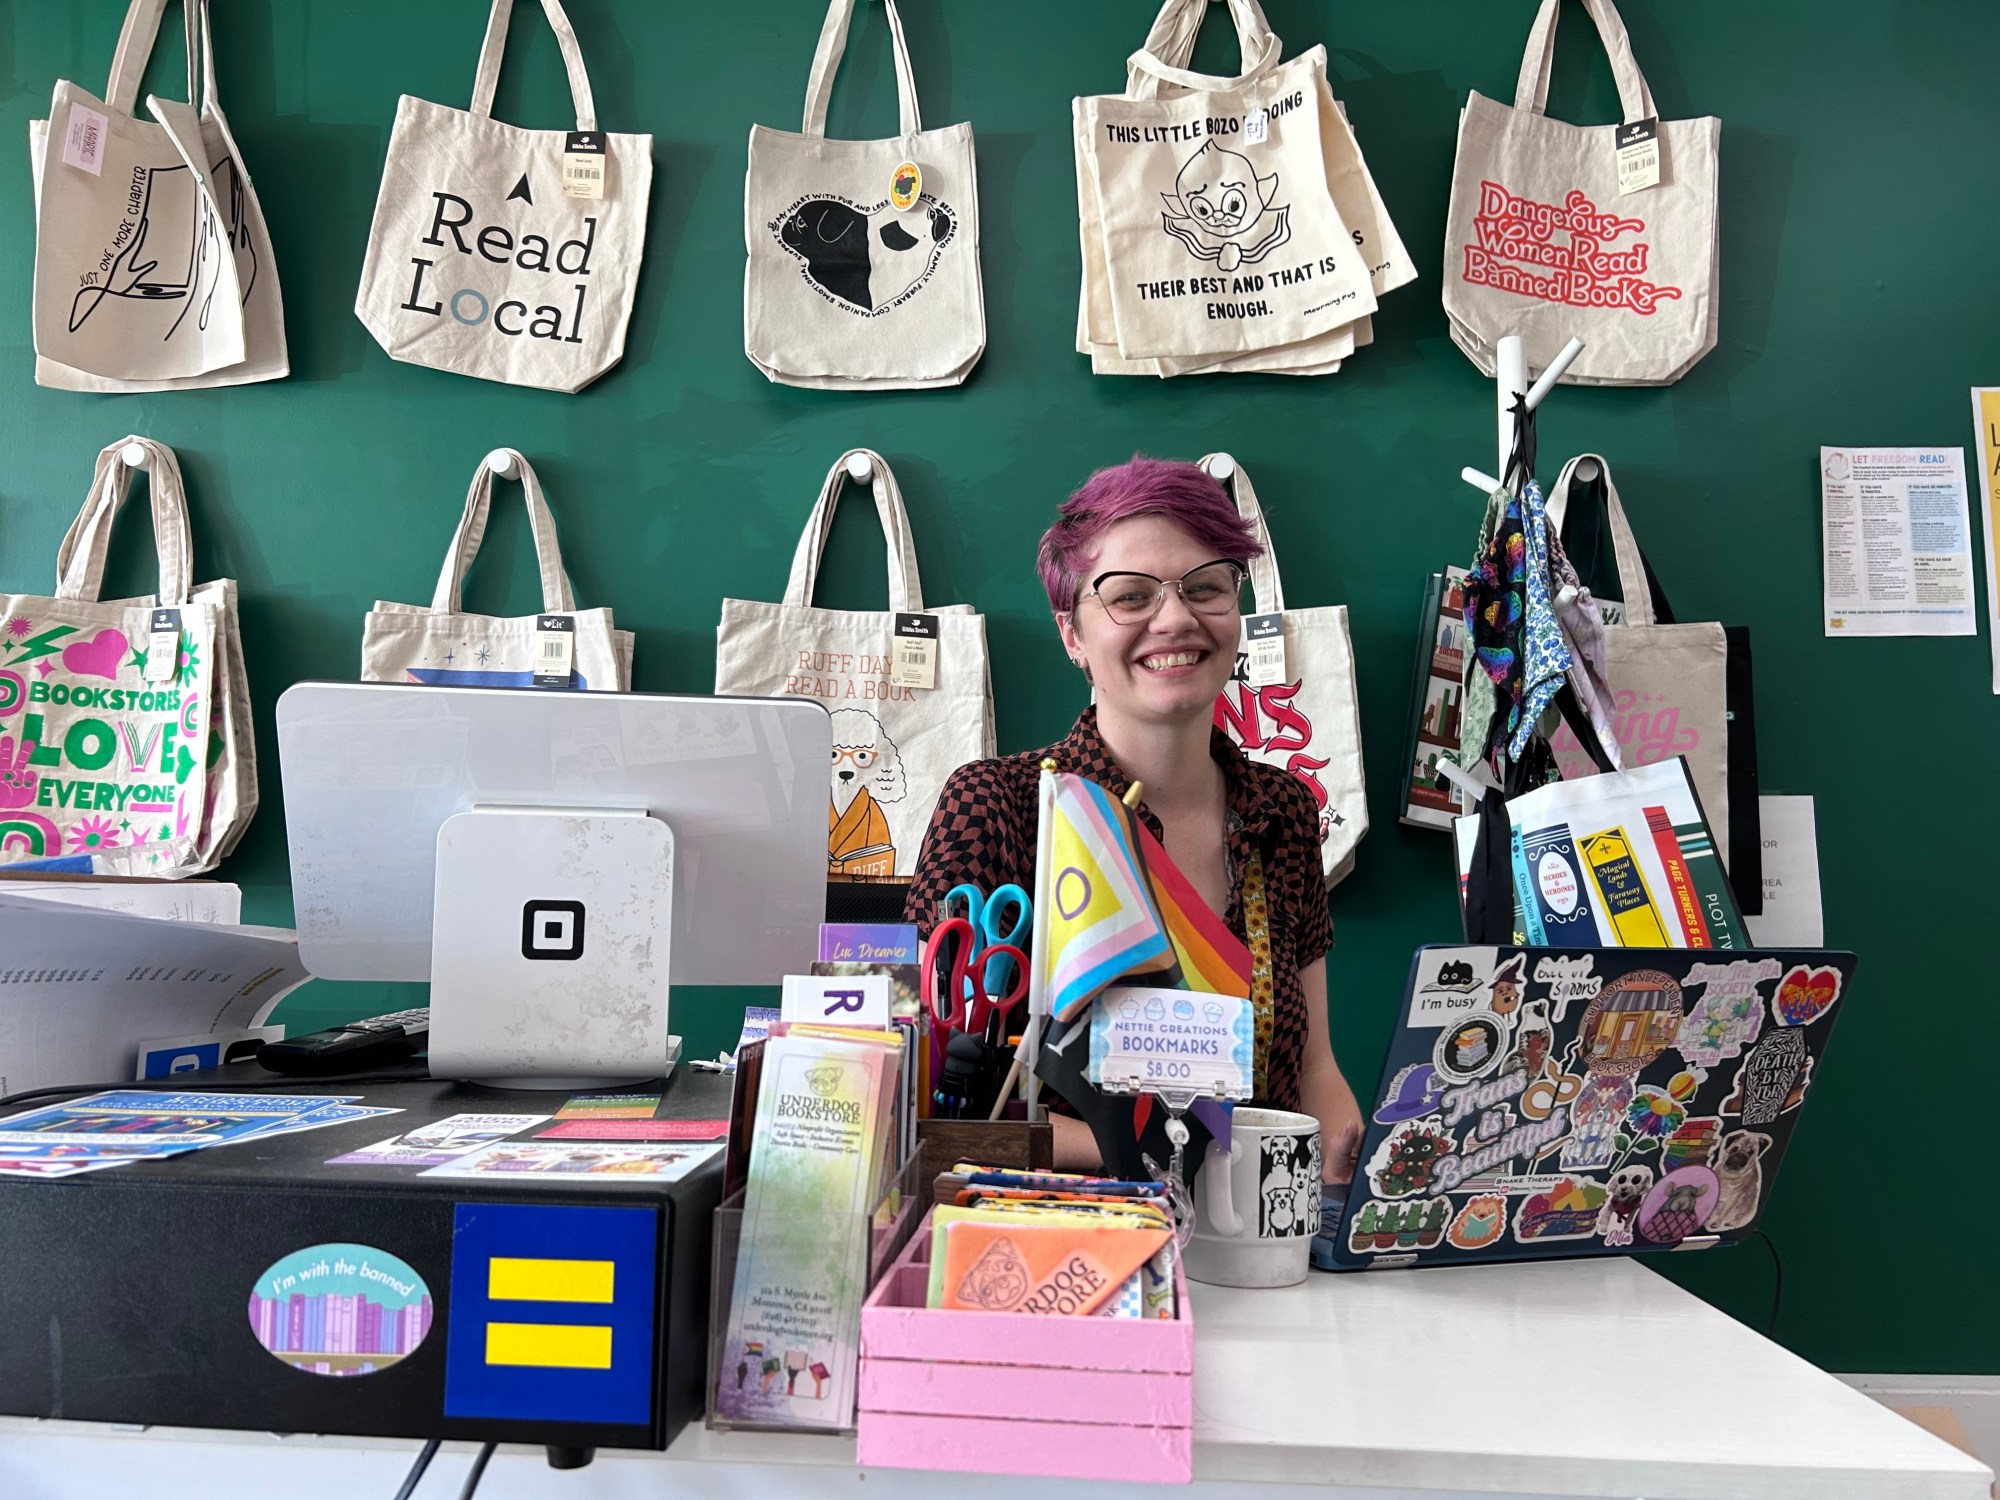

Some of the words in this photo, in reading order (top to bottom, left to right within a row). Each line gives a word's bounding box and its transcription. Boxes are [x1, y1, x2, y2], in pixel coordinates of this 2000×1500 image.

[1107, 124, 1140, 143] THIS
[1144, 120, 1201, 143] LITTLE
[1206, 117, 1239, 135] BOZO
[787, 194, 811, 217] HEART
[812, 193, 836, 201] WITH
[837, 195, 854, 206] FUR
[854, 203, 871, 213] AND
[940, 202, 956, 218] BEST
[1480, 180, 1646, 241] Dangerous
[422, 191, 597, 276] Read
[79, 271, 99, 287] JUST
[100, 248, 115, 272] ONE
[112, 221, 136, 250] MORE
[1474, 218, 1572, 271] Women
[1570, 232, 1649, 280] Read
[1137, 278, 1186, 301] THEIR
[1190, 277, 1228, 295] BEST
[1232, 274, 1264, 295] AND
[1268, 263, 1313, 289] THAT
[1320, 256, 1336, 276] IS
[1463, 245, 1568, 302] Banned
[401, 258, 587, 344] Local
[1207, 300, 1274, 320] ENOUGH.
[1852, 455, 1869, 464] LET
[1872, 455, 1917, 464] FREEDOM
[798, 651, 853, 674] RUFF
[29, 680, 182, 712] BOOKSTORES
[785, 675, 838, 699] READ
[846, 681, 860, 699] A
[21, 713, 179, 773] LOVE
[37, 777, 176, 812] EVERYONE
[1761, 840, 1778, 849] OR
[1543, 871, 1568, 882] HEROES
[1598, 859, 1630, 877] Magical
[1607, 872, 1628, 884] Lands
[1519, 872, 1529, 895] Once
[1525, 896, 1535, 919] Upon
[1545, 884, 1576, 896] HEROINES
[1608, 887, 1641, 903] Faraway
[1667, 859, 1684, 882] PAGE
[1677, 885, 1698, 926] TURNERS
[1617, 896, 1641, 908] Places
[1705, 893, 1728, 928] PLOT
[858, 942, 910, 960] Dreamer
[1584, 977, 1631, 1025] SUPPORT
[1633, 971, 1681, 1023] INDEPENDENT
[1707, 982, 1755, 996] SOCIETY
[1421, 999, 1442, 1010] I'm
[1446, 997, 1478, 1010] busy
[1115, 1022, 1155, 1033] NETTIE
[1160, 1024, 1229, 1036] CREATIONS
[1122, 1036, 1219, 1056] BOOKMARKS
[1146, 1062, 1191, 1078] $8.00
[1584, 1052, 1614, 1074] BOOK
[1755, 1053, 1800, 1071] DEATH
[1763, 1069, 1781, 1084] BY
[781, 1094, 861, 1113] UNDERDOG
[1441, 1068, 1529, 1126] Trans
[777, 1104, 861, 1124] BOOKSTORE
[1476, 1109, 1504, 1141] is
[1429, 1106, 1567, 1195] Beautiful
[1606, 1229, 1633, 1246] Mia
[272, 1274, 297, 1295] I'm
[299, 1260, 330, 1281] with
[333, 1258, 356, 1276] the
[359, 1261, 416, 1297] banned
[1015, 1256, 1089, 1314] RDOG
